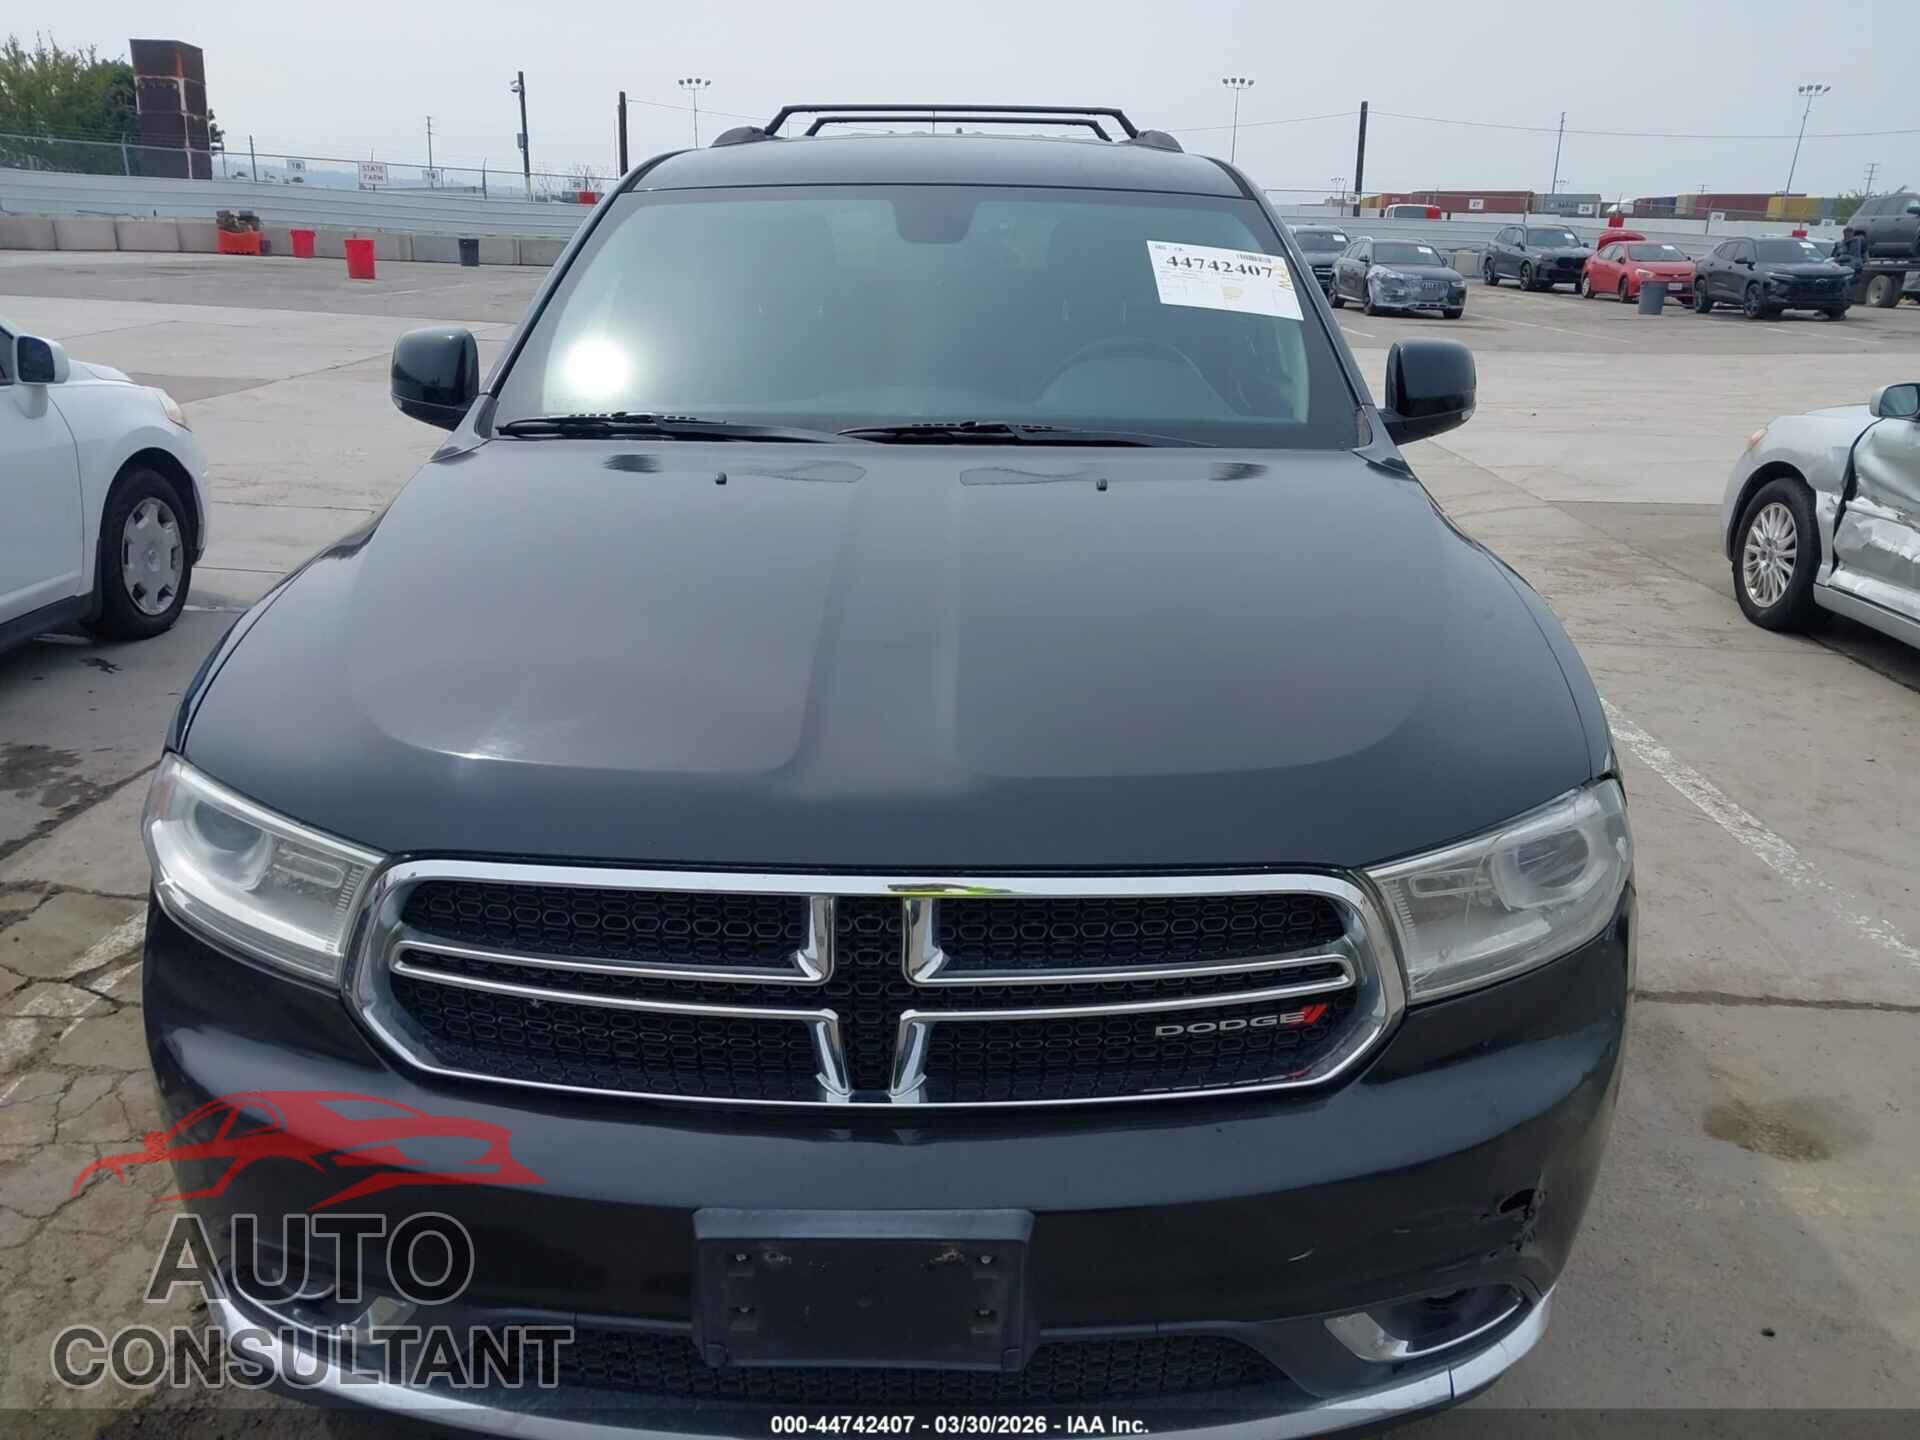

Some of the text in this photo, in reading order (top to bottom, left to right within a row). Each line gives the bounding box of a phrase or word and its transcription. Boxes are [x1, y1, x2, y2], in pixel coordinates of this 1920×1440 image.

[362, 164, 384, 172] STATE
[363, 174, 384, 182] FARM
[1166, 255, 1272, 279] 44742407
[1154, 1011, 1305, 1037] DODGE
